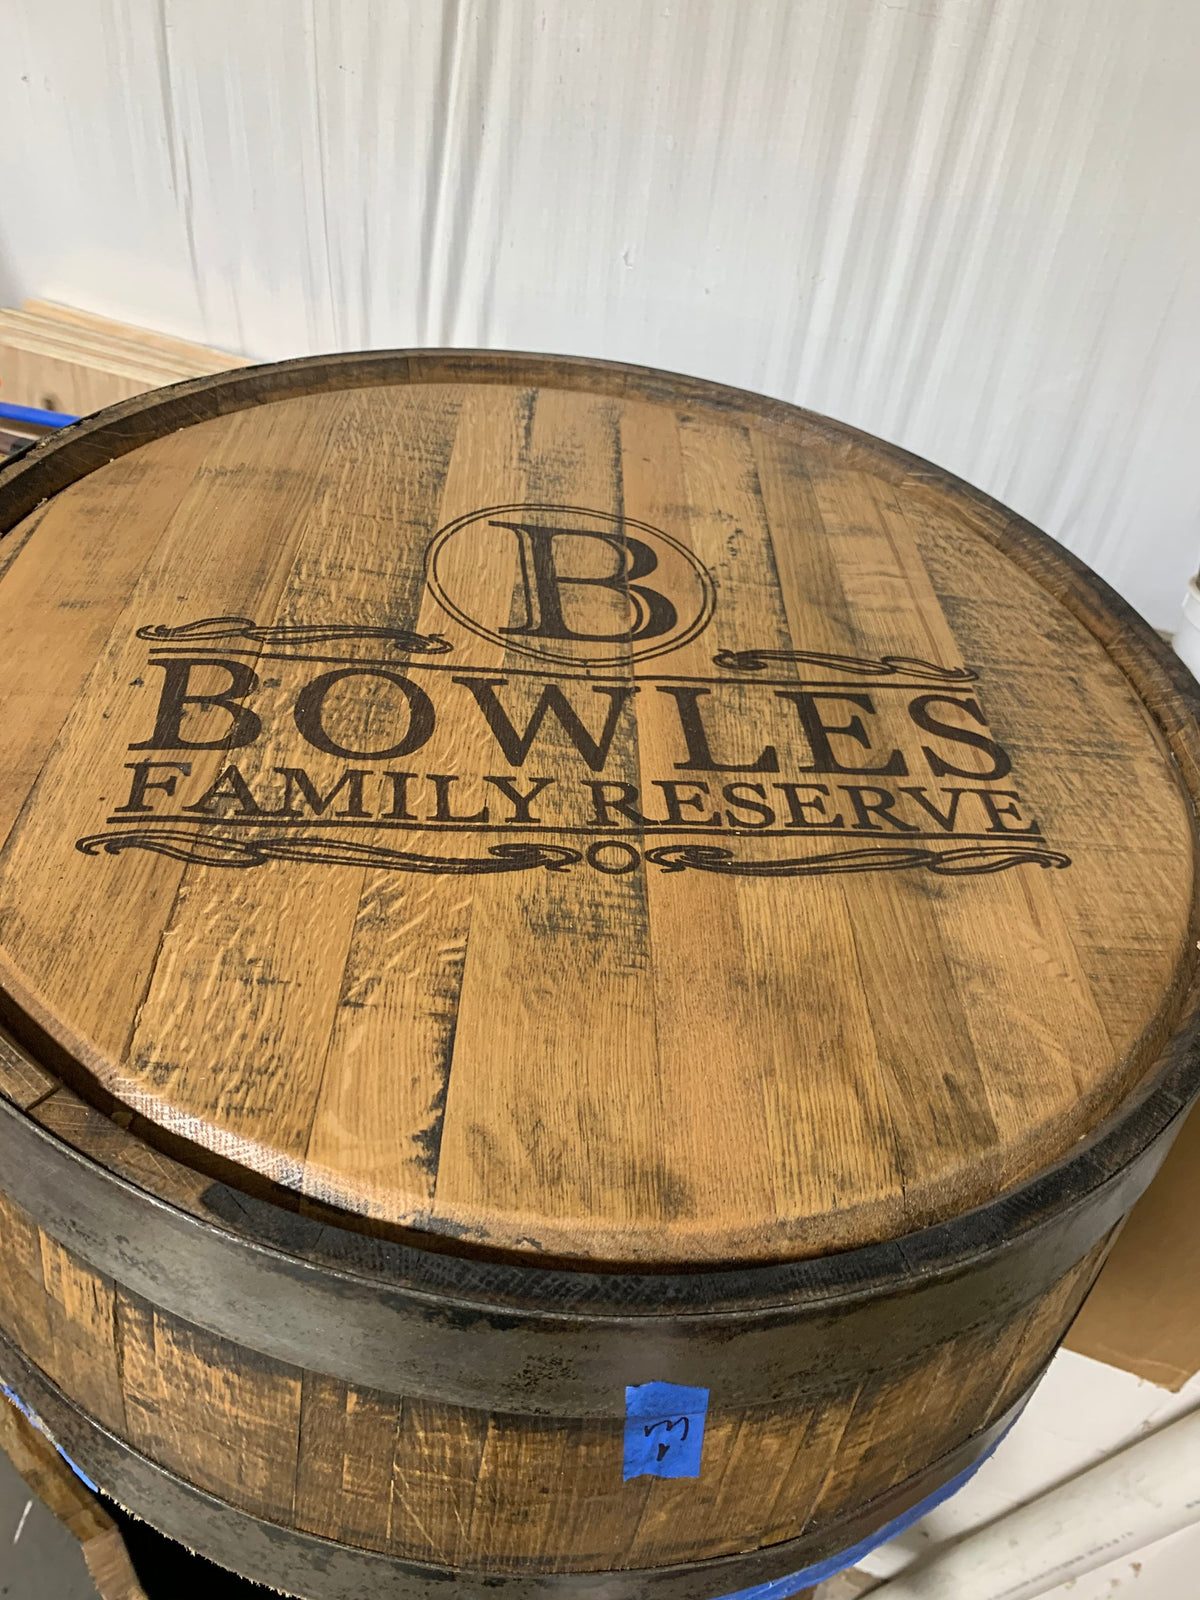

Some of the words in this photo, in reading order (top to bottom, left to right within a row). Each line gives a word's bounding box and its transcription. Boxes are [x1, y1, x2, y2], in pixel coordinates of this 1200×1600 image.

[488, 520, 677, 642] B
[128, 657, 1012, 781] BOWLES
[114, 762, 556, 825] FAMILY
[580, 779, 1041, 835] RESERVE
